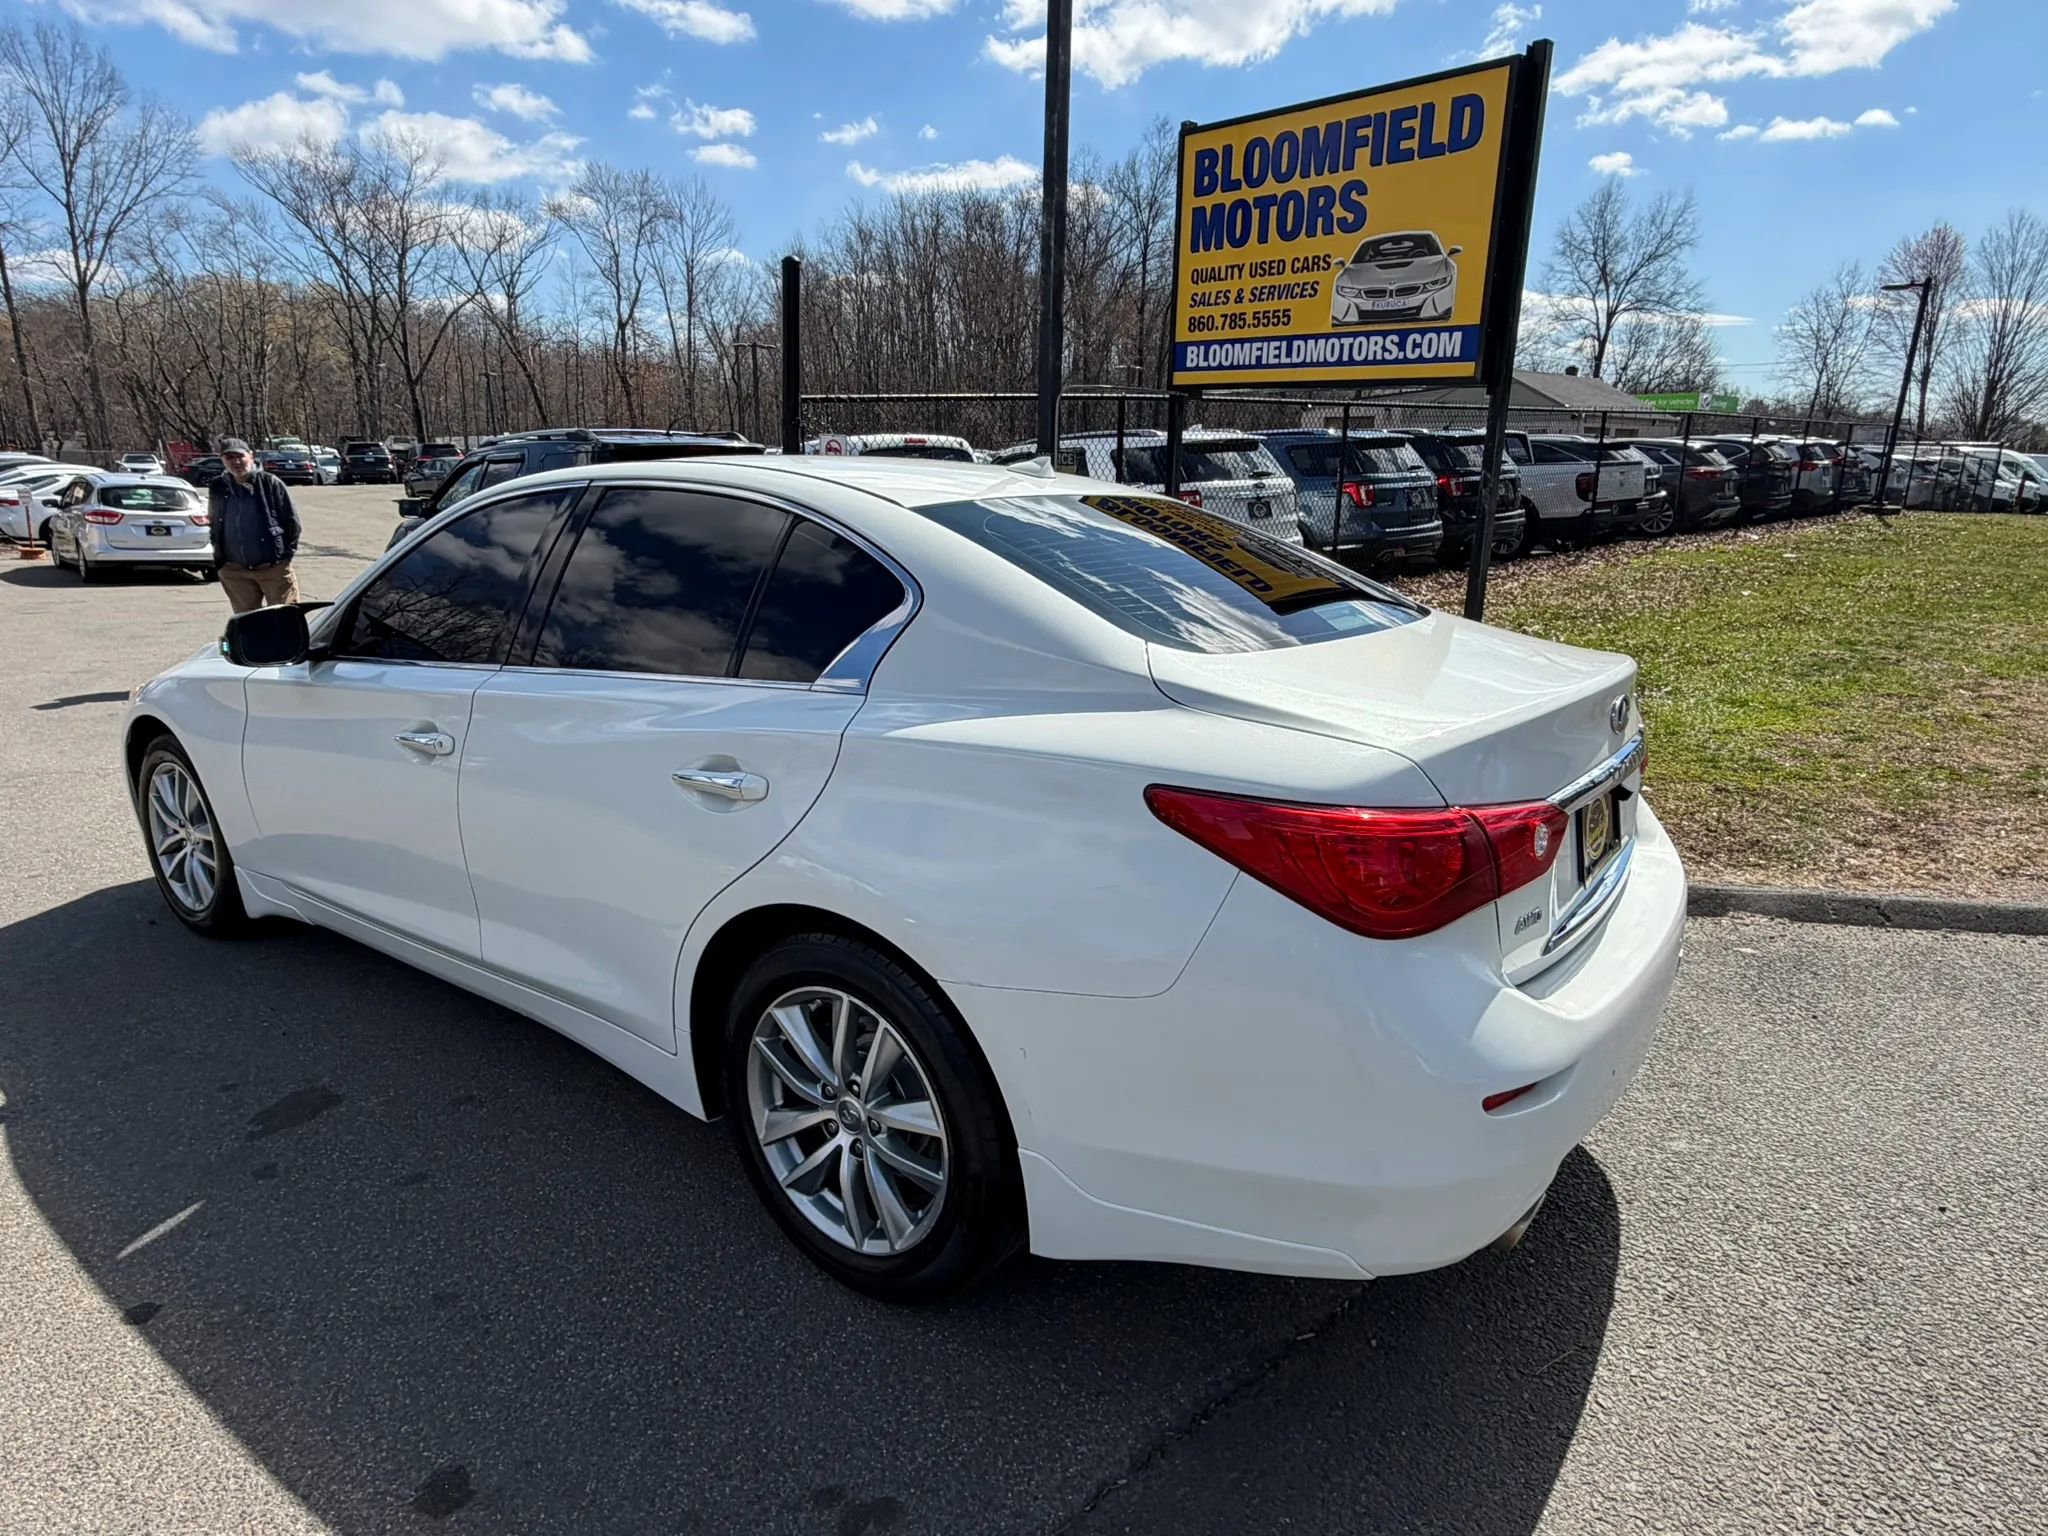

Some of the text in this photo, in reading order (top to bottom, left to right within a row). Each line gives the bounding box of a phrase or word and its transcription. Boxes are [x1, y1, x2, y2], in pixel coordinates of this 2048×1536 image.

[1193, 93, 1485, 198] BLOOMFIELD
[1190, 179, 1369, 253] MOTORS
[1190, 254, 1332, 285] QUALITY USED CARS
[1188, 280, 1320, 308] SALES & SERVICES
[1188, 308, 1292, 333] 860.785.5555
[1185, 331, 1463, 368] BLOOMFIELDMOTORS.COM
